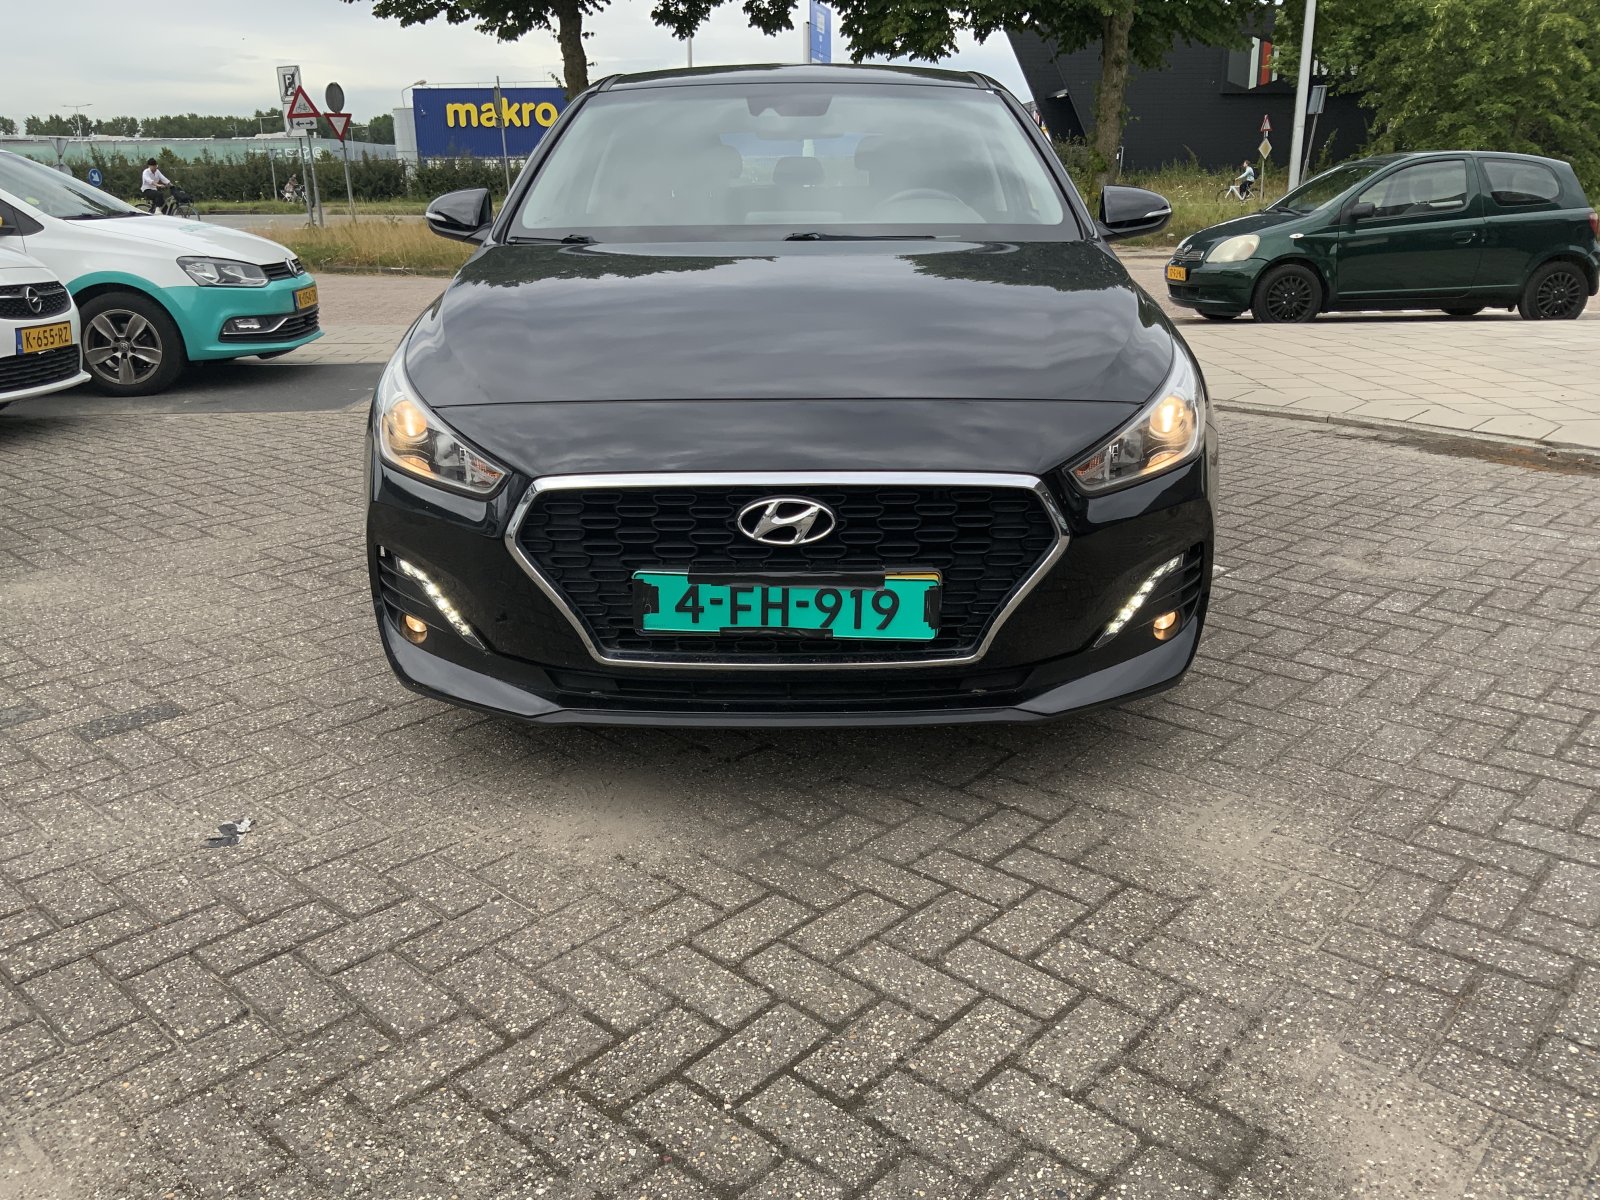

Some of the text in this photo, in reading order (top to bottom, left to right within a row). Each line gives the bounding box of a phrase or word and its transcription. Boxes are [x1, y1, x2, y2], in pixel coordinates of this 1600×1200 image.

[446, 97, 558, 127] makro
[25, 327, 69, 349] K-655-RZ
[674, 585, 900, 630] 4-FH-919
